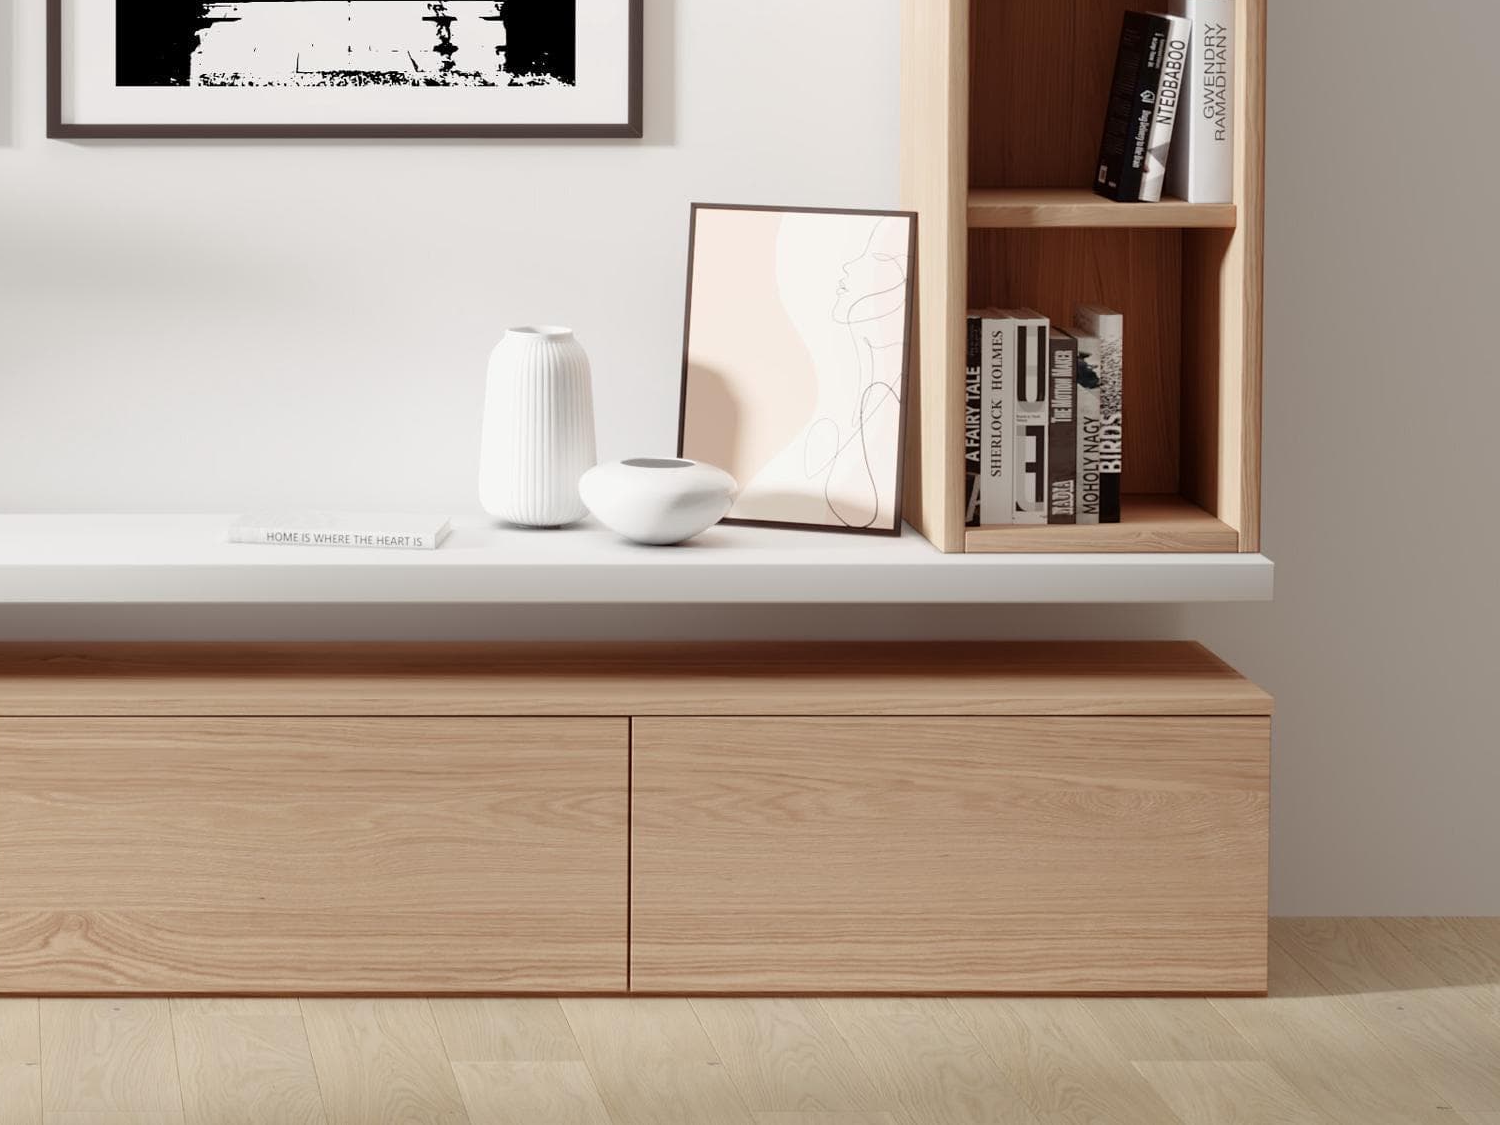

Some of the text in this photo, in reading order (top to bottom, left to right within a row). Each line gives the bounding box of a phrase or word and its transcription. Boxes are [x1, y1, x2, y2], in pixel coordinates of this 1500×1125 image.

[1156, 39, 1186, 125] NTEDBABOO
[1203, 23, 1215, 120] GWENDRY
[1215, 24, 1227, 141] RAMADHANY
[966, 366, 981, 403] TALE
[990, 330, 1003, 477] SHERLOCK HOLMES
[1051, 350, 1073, 423] THE MOTION MAKER
[966, 406, 980, 447] FAIRY
[966, 450, 980, 462] A
[1100, 413, 1122, 473] BIRDS
[1051, 479, 1074, 515] NADIA
[1083, 416, 1099, 515] MOHOLY NAGY
[266, 531, 423, 547] HOME IS WHERE THE HEART IS
